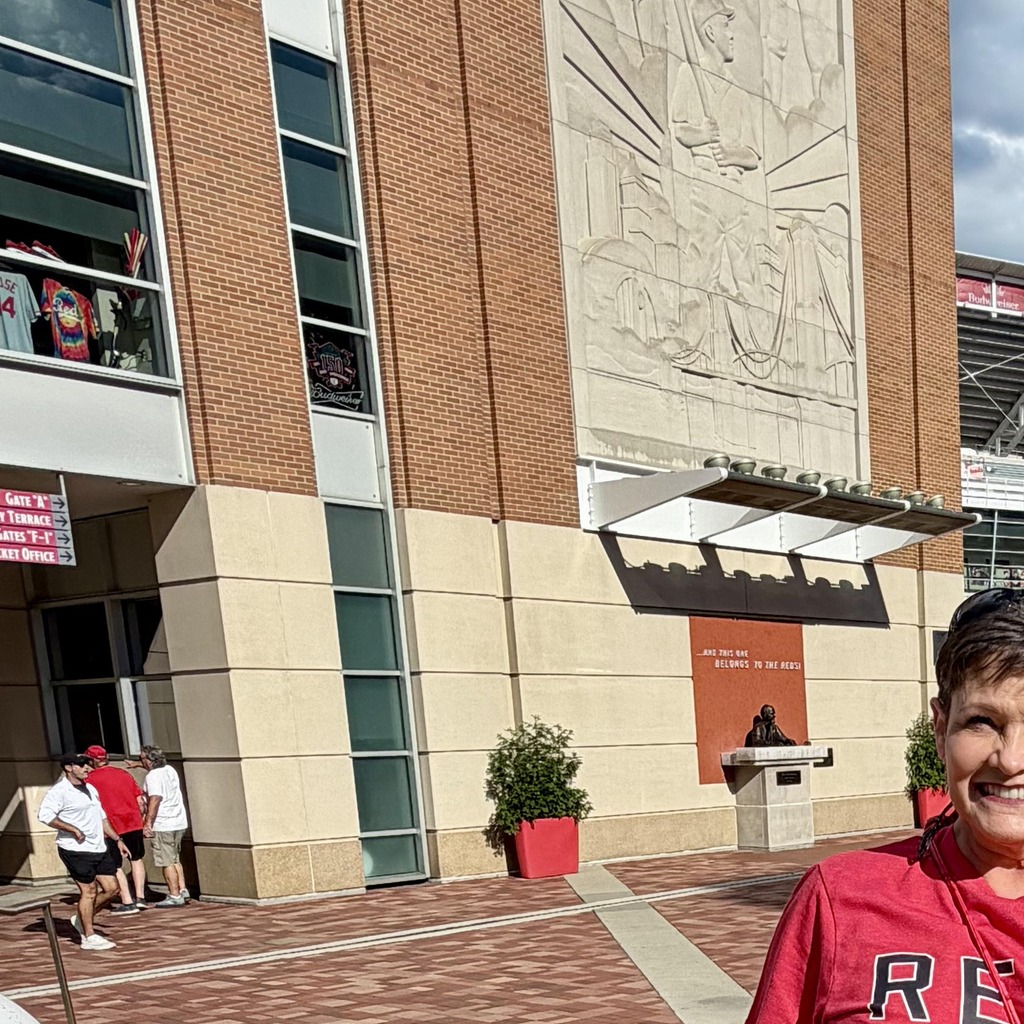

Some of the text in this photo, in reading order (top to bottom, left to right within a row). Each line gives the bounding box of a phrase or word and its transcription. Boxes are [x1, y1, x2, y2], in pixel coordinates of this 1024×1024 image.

[5, 491, 32, 507] GATE
[7, 510, 52, 526] TERRACE
[0, 528, 26, 542] ATES
[0, 547, 56, 563] KET OFFICE
[719, 649, 734, 657] THIS
[714, 659, 750, 669] BELONGS
[753, 660, 763, 669] TO
[765, 661, 778, 670] THE
